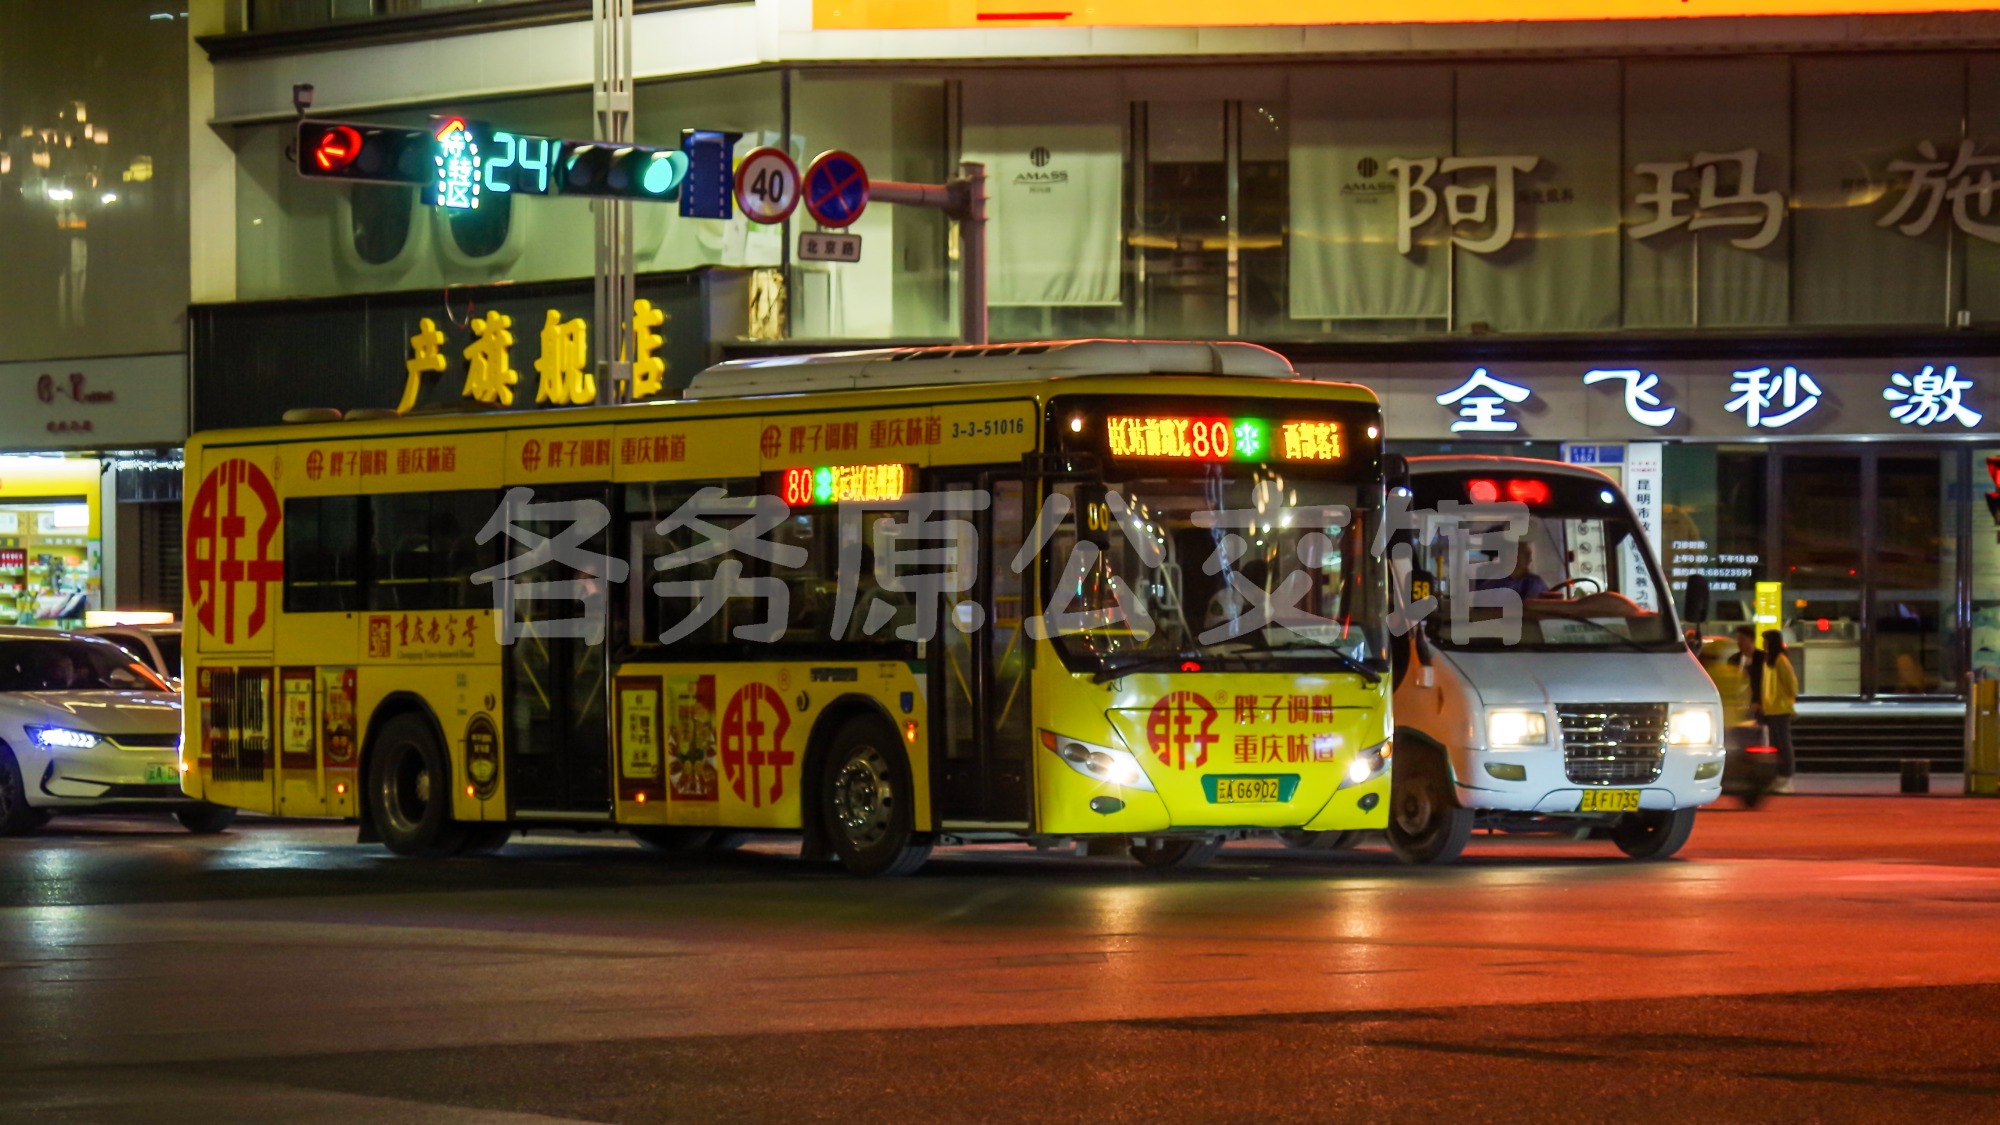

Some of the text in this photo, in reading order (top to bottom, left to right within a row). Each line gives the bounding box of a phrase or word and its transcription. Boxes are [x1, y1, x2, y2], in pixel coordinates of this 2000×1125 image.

[485, 132, 549, 192] 24
[1013, 170, 1068, 184] AMASS
[751, 168, 784, 203] 40
[806, 239, 855, 256] 北京路
[1436, 367, 1983, 432] 全飞秒激
[789, 415, 941, 453] 胖子调料 重庆味道
[952, 418, 1024, 438] 3-3-51016
[1192, 421, 1229, 458] 80
[330, 445, 456, 477] 胖子调料 重庆味道
[547, 434, 686, 468] 胖子调料 重庆味道
[788, 469, 813, 503] 80
[395, 613, 478, 648] 重庆老字号
[1234, 694, 1334, 725] 胖子调料
[1234, 733, 1335, 763] 重庆味道
